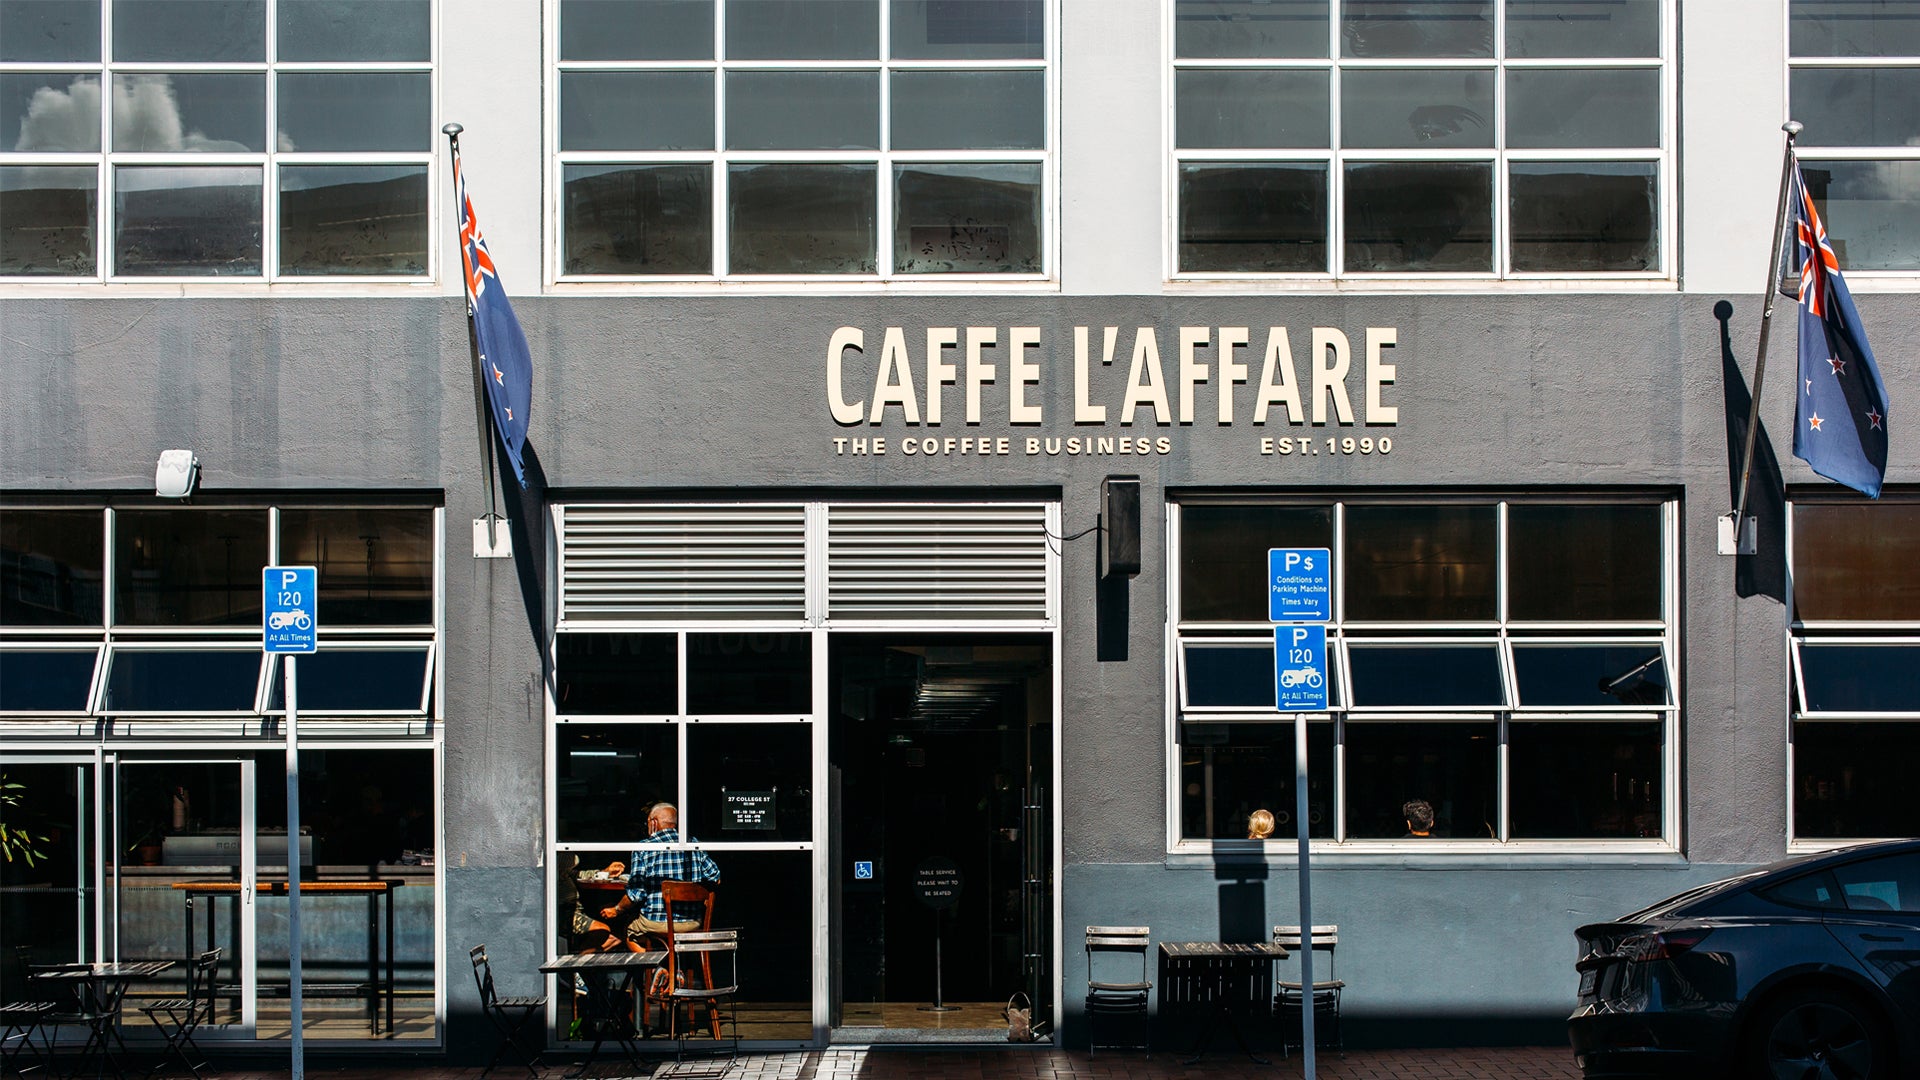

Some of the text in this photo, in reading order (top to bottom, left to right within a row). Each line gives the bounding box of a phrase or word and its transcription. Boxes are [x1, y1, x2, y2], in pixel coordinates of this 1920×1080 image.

[827, 326, 1398, 425] CAFFE L'AFFARE
[833, 438, 1171, 455] THE COFFEE BUSINESS
[1285, 552, 1314, 572] P $
[282, 571, 297, 590] P
[1276, 575, 1313, 583] Conditions
[1272, 585, 1298, 594] Parking
[278, 592, 301, 606] 120
[1303, 598, 1319, 606] Vary
[290, 633, 311, 641] Times
[1293, 628, 1308, 647] P
[1289, 649, 1312, 664] 120
[1281, 692, 1323, 700] At All Times
